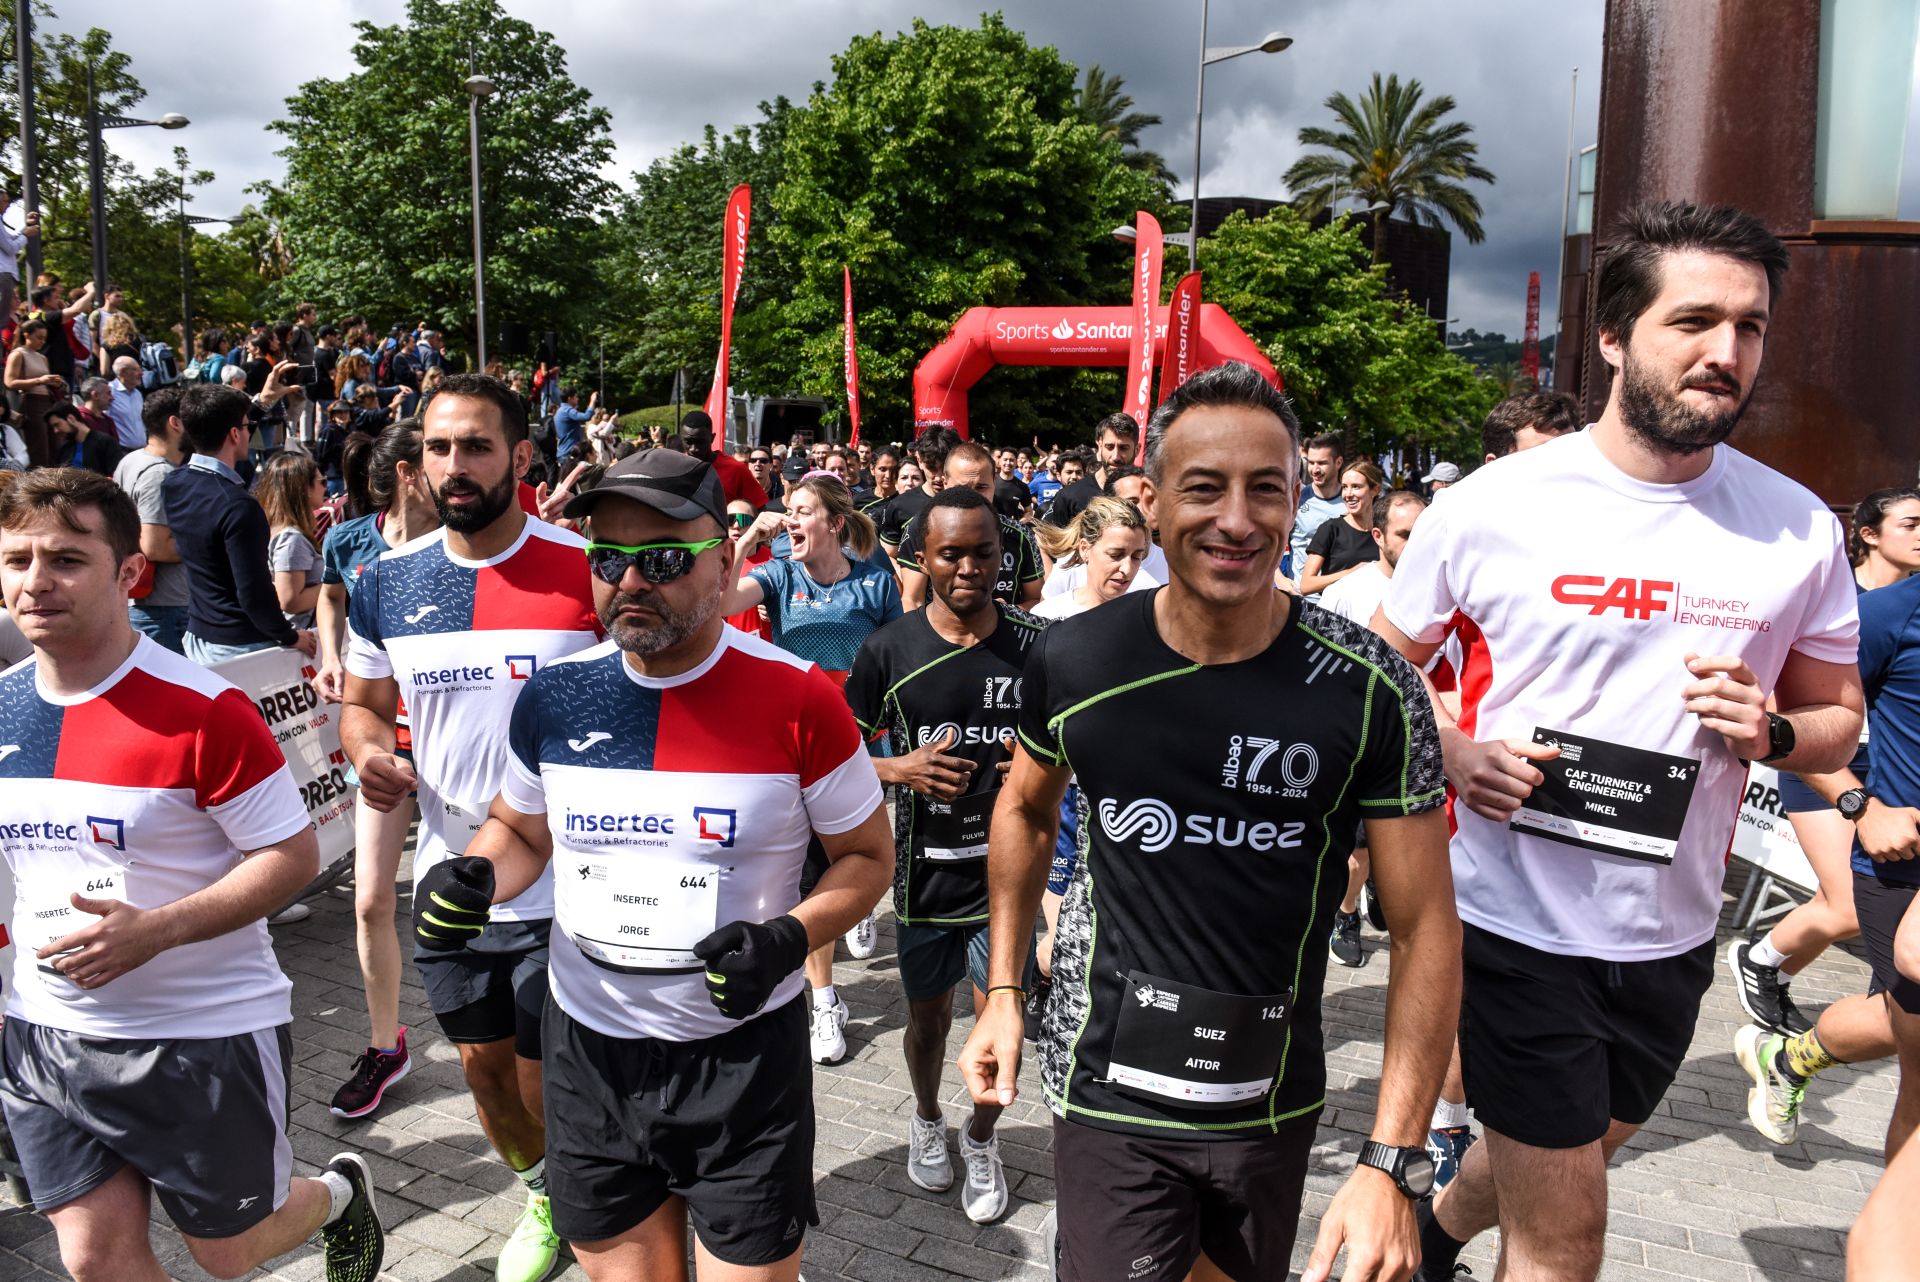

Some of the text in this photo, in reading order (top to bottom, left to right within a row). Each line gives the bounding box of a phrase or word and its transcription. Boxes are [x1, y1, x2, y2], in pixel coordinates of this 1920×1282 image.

[996, 322, 1168, 343] Sports Santaner
[1175, 289, 1191, 388] antander
[919, 406, 942, 416] Sports
[1551, 574, 1674, 620] CAF
[1682, 595, 1750, 613] TURNKEY
[1680, 612, 1771, 633] ENGINEERING
[412, 666, 494, 686] insertec
[451, 684, 492, 692] Refractories
[255, 678, 317, 726] RREO
[308, 713, 329, 728] VALOR
[965, 726, 1017, 745] sue
[1221, 735, 1243, 788] bilbao
[1246, 736, 1319, 788] 70
[1565, 768, 1652, 794] CAF TURNKEY &
[1667, 766, 1687, 781] 34
[1246, 783, 1272, 795] 1954
[1281, 788, 1308, 798] 2024
[1568, 779, 1643, 803] ENGINEERING
[319, 799, 354, 825] BALIOTSUA
[1585, 802, 1618, 816] MIKEL
[566, 807, 674, 834] insertec
[963, 815, 981, 823] SUEZ
[1757, 820, 1775, 832] CON
[0, 821, 77, 841] nsertec
[962, 832, 985, 840] FULVIO
[1184, 814, 1306, 851] suez
[566, 835, 601, 845] Furnaces
[614, 838, 669, 848] Refractories
[87, 878, 113, 891] 644
[680, 876, 707, 888] 644
[614, 894, 658, 906] INSERTEC
[35, 908, 70, 919] INSERTEC
[618, 925, 650, 936] JORGE
[1262, 1006, 1284, 1020] 142
[1194, 1027, 1226, 1040] SUEZ
[1185, 1058, 1220, 1071] AITOR
